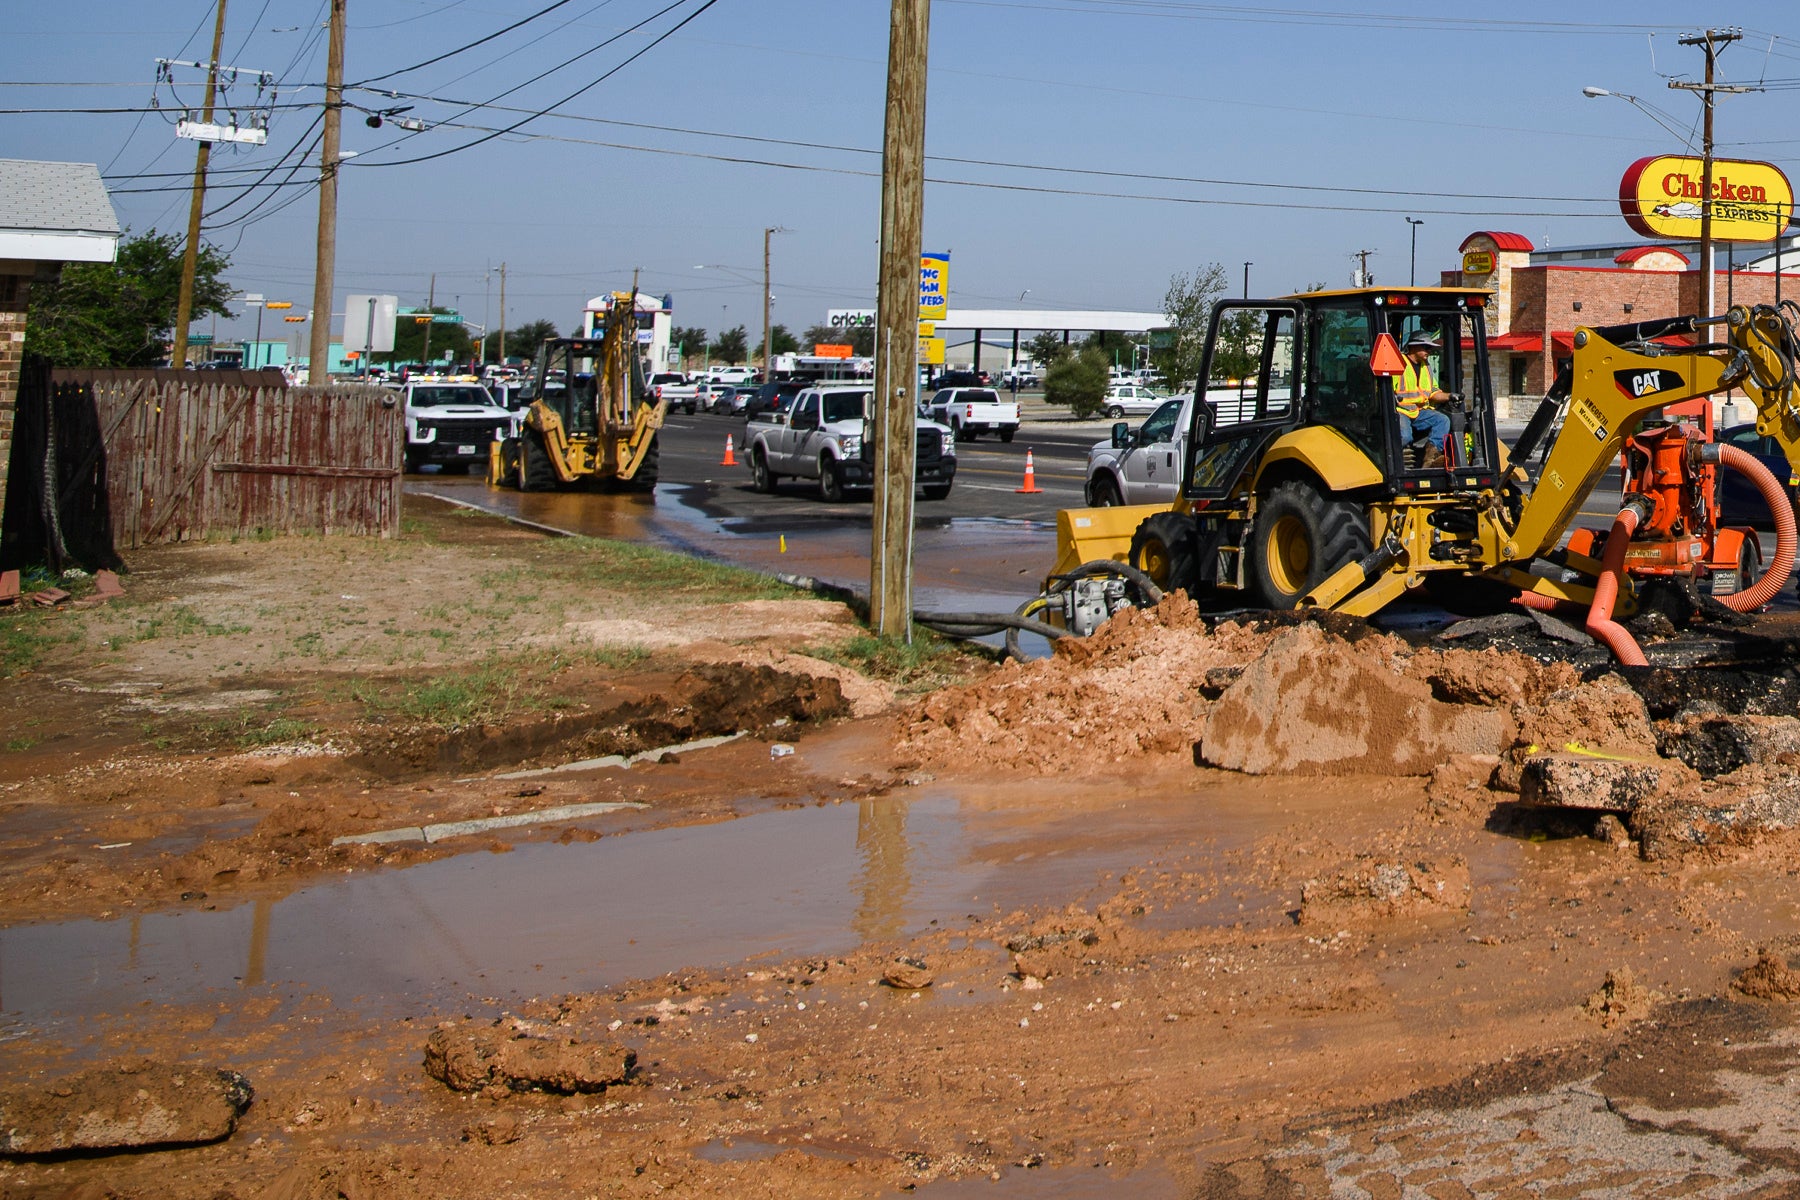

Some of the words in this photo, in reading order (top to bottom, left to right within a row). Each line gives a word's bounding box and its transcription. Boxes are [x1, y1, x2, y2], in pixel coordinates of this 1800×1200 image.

[1661, 172, 1767, 203] Chicken
[1715, 207, 1769, 221] EXPRESS
[1632, 370, 1660, 397] CAT
[1596, 427, 1607, 439] CAT
[1647, 550, 1661, 558] Trust
[1715, 571, 1736, 580] godwin
